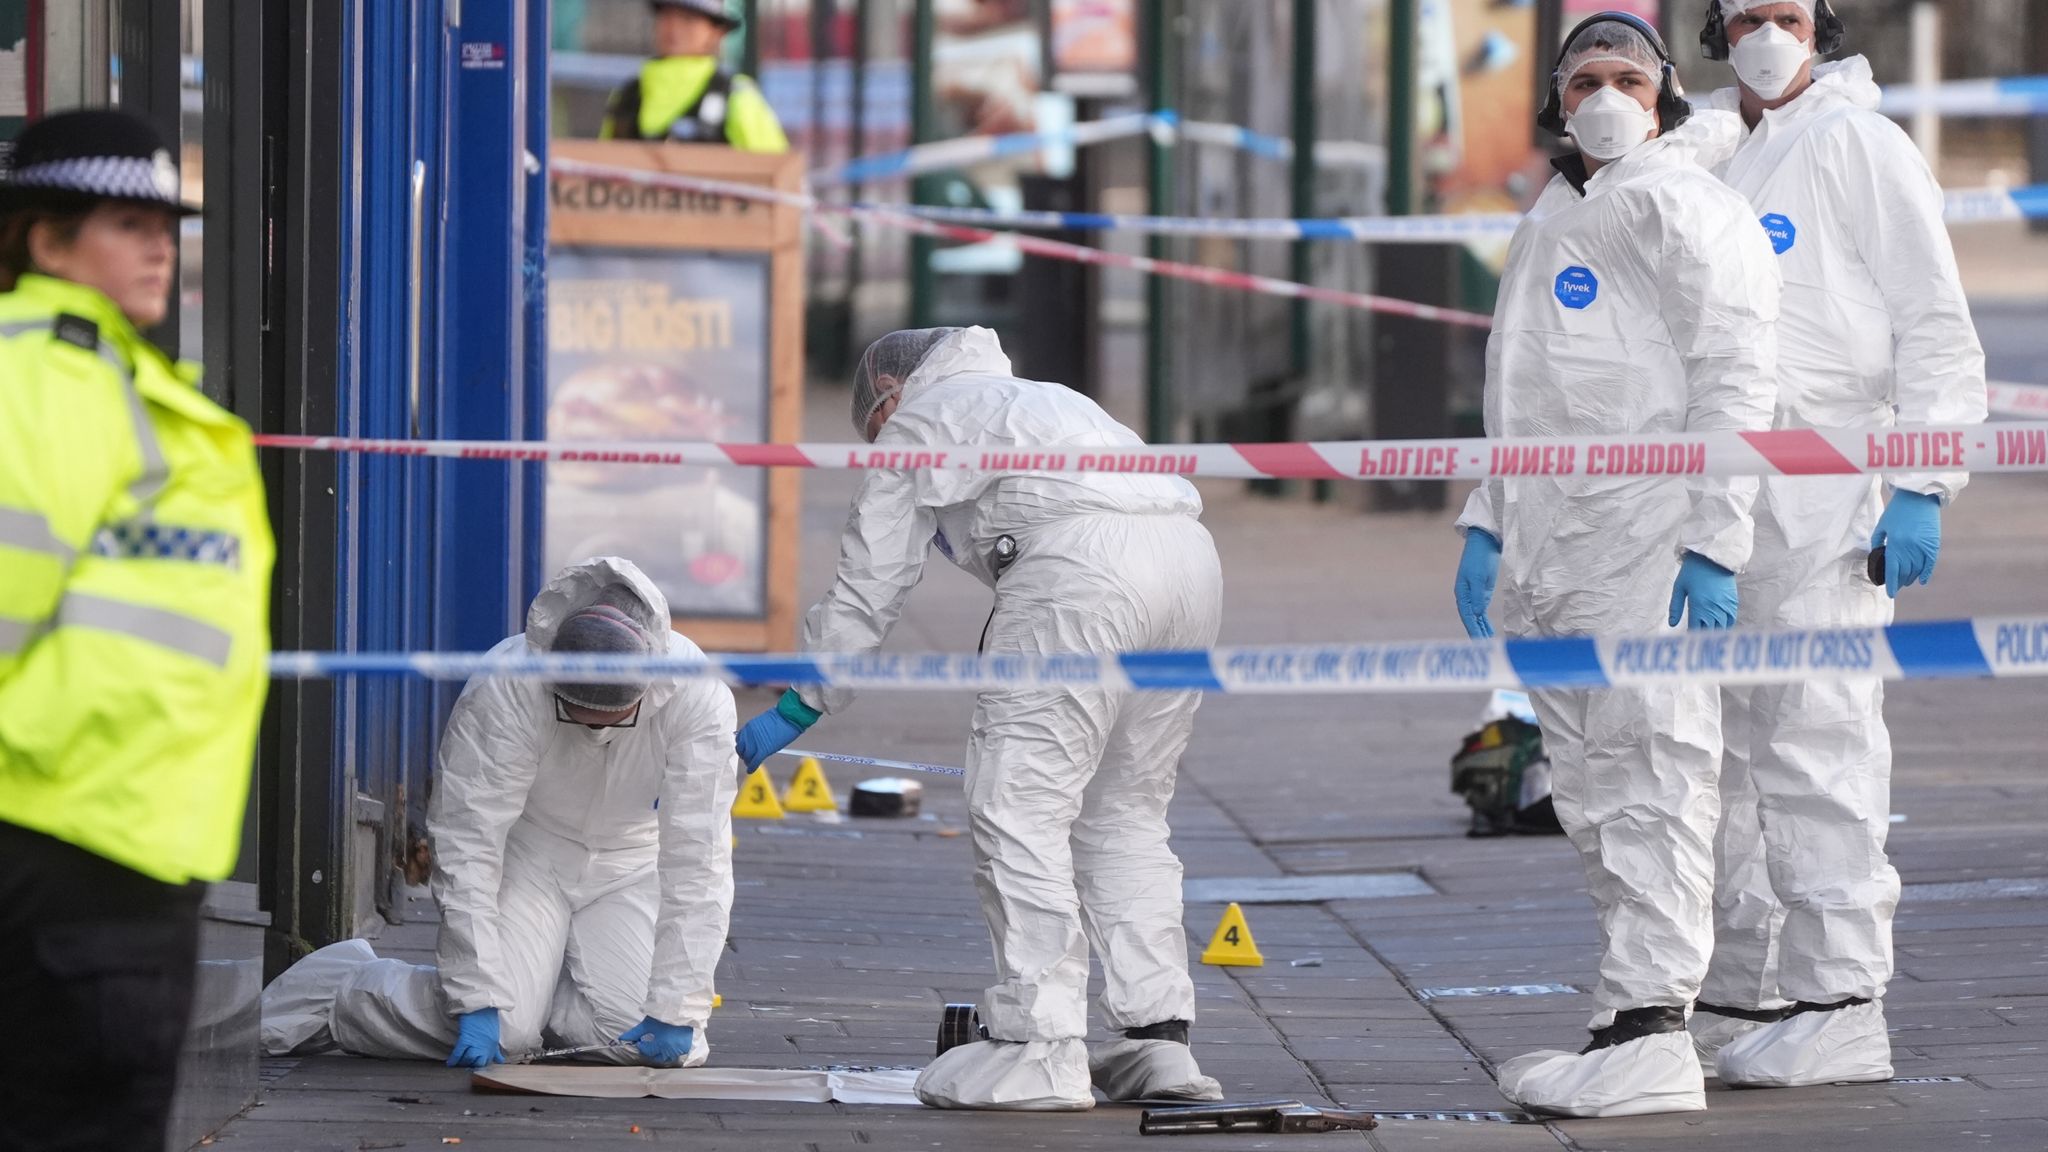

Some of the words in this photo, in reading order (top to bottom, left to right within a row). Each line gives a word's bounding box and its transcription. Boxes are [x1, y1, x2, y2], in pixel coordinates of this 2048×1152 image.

[550, 176, 750, 214] cDonalds
[1763, 226, 1788, 239] yvek
[1562, 281, 1590, 293] Tyvek
[1614, 636, 1683, 674] POLICE
[1686, 634, 1729, 673] LINE
[1732, 633, 1763, 671] DO
[1767, 631, 1808, 670] NOT
[1808, 628, 1875, 669] CROSS
[750, 785, 765, 804] 3
[804, 778, 818, 797] 2
[1223, 925, 1240, 946] 4
